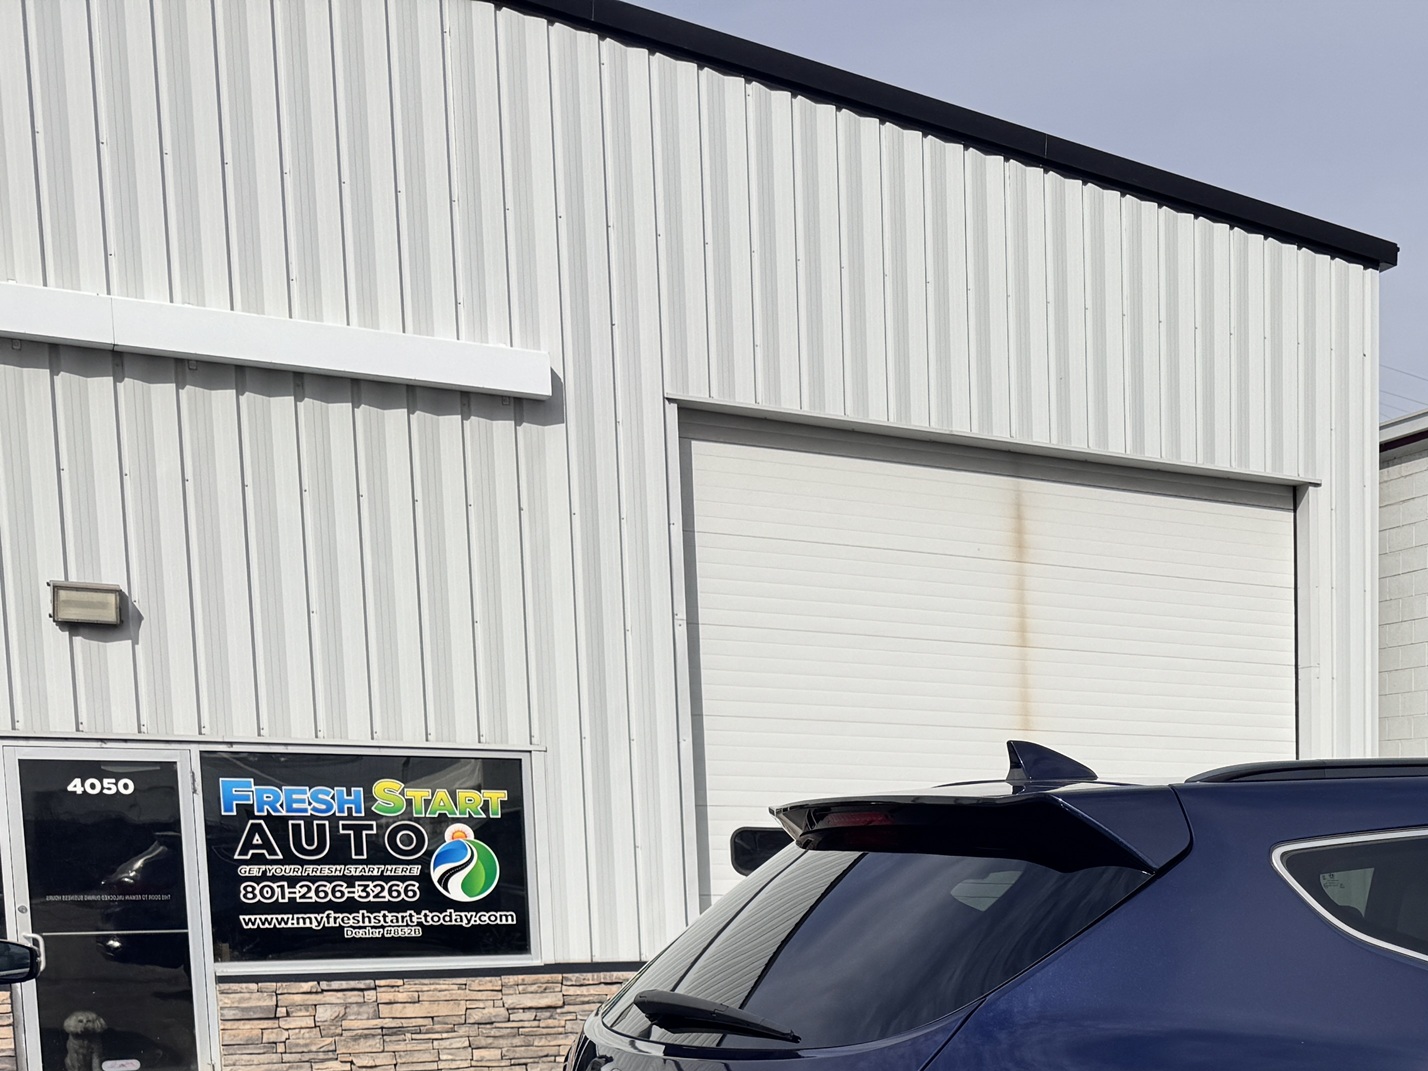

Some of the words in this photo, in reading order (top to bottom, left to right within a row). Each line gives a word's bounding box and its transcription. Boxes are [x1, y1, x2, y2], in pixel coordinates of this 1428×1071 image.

[67, 777, 135, 795] 4050
[219, 778, 365, 816] FRESH
[371, 778, 508, 818] START
[233, 820, 429, 860] AUTO
[238, 865, 265, 876] GET
[265, 865, 302, 876] YOUR
[302, 865, 345, 876] FRESH
[344, 864, 384, 876] START
[384, 864, 421, 876] HERE!
[240, 881, 420, 904] 801-266-3266
[239, 909, 516, 930] www.myfreshstart-today.com
[344, 927, 383, 938] Dealer
